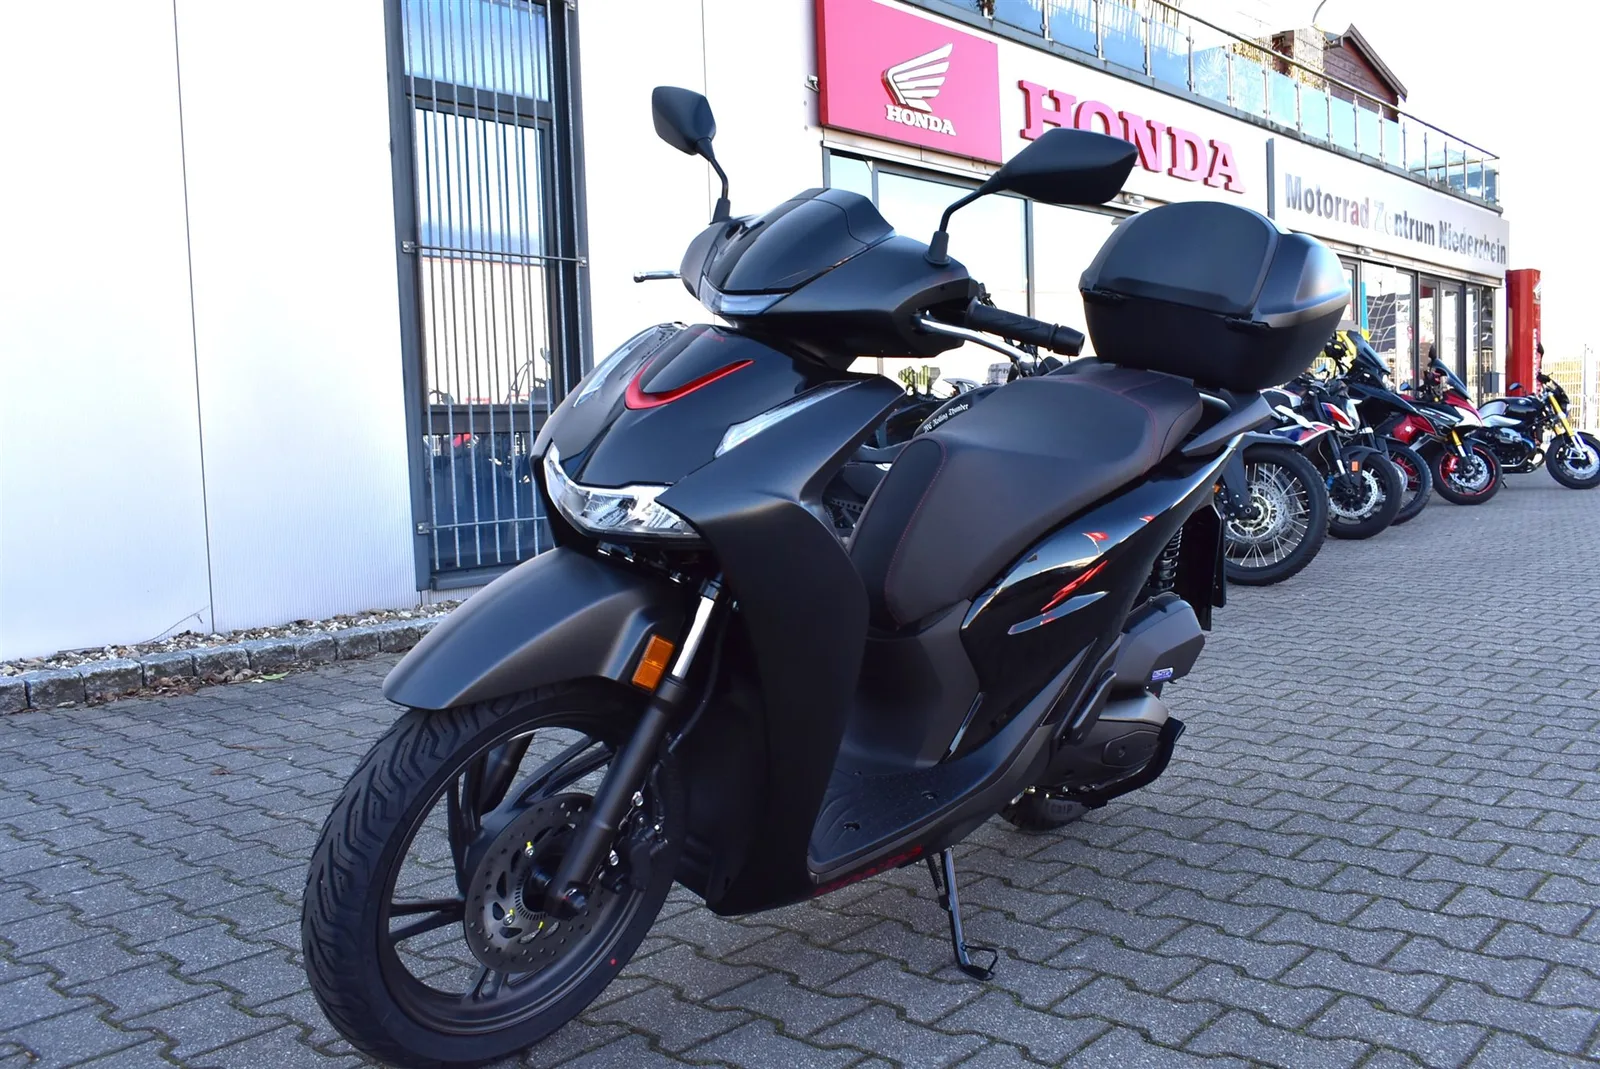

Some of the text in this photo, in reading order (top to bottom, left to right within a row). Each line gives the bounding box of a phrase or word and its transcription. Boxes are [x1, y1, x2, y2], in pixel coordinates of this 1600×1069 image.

[885, 104, 957, 136] HONDA
[1017, 79, 1246, 194] HONDA
[1285, 172, 1369, 229] Motorrad
